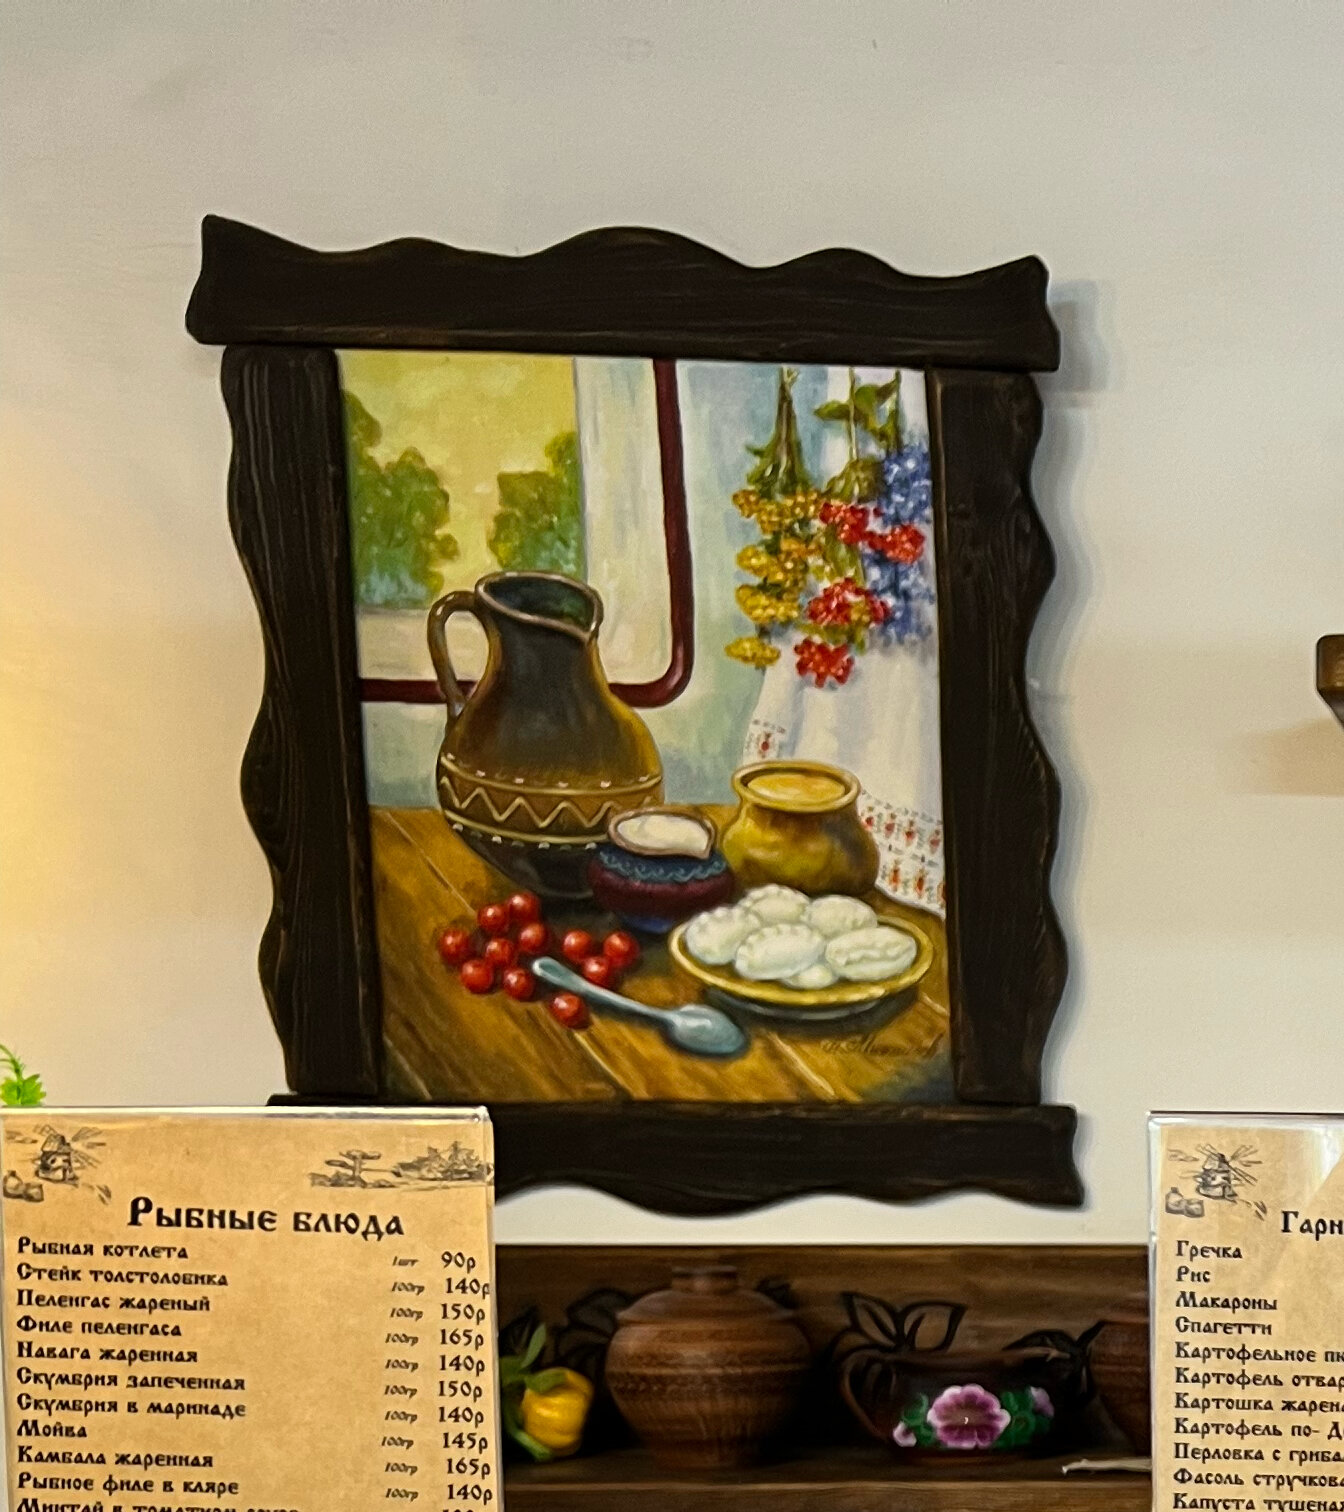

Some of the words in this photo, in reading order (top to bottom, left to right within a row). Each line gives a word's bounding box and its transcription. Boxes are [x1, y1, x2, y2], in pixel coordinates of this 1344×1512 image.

[126, 1196, 278, 1232] Рыбные
[292, 1211, 405, 1242] блюда
[17, 1236, 94, 1257] Рыбная
[102, 1244, 189, 1259] котлета
[440, 1250, 476, 1274] 90р
[1175, 1239, 1243, 1262] Гречка
[16, 1262, 82, 1282] Стейк
[1175, 1265, 1211, 1284] Рис
[16, 1288, 111, 1309] Пеленгас
[118, 1295, 210, 1315] жареный
[440, 1302, 486, 1326] 150р
[1175, 1290, 1278, 1315] Макароны
[16, 1314, 73, 1334] Филе
[81, 1321, 182, 1337] пеленгаса
[440, 1327, 484, 1352] 165р
[1175, 1315, 1272, 1336] Спагетти
[17, 1340, 91, 1360] Навага
[98, 1348, 198, 1367] жаренная
[439, 1354, 486, 1378] 140р
[1174, 1341, 1317, 1366] Картофельное
[16, 1366, 118, 1391] Скумбрия
[125, 1375, 246, 1391] запеченная
[438, 1380, 483, 1403] 150р
[1174, 1366, 1284, 1391] Картофель
[16, 1392, 118, 1418] Скумбрия
[126, 1401, 139, 1414] в
[146, 1402, 246, 1420] маринаде
[438, 1406, 485, 1429] 140р
[1174, 1391, 1274, 1414] Картошка
[16, 1419, 88, 1438] Мойва
[442, 1432, 488, 1455] 145р
[1173, 1417, 1283, 1441] Картофель
[17, 1445, 107, 1465] Камбала
[114, 1453, 214, 1472] жаренная
[446, 1456, 491, 1480] 165р
[1173, 1442, 1265, 1465] Перловка
[1272, 1448, 1281, 1462] с
[17, 1471, 94, 1492] Рыбное
[102, 1473, 155, 1497] филе
[162, 1480, 175, 1493] в
[182, 1481, 239, 1499] кляре
[447, 1483, 493, 1506] 140р
[1173, 1467, 1245, 1486] Фасоль
